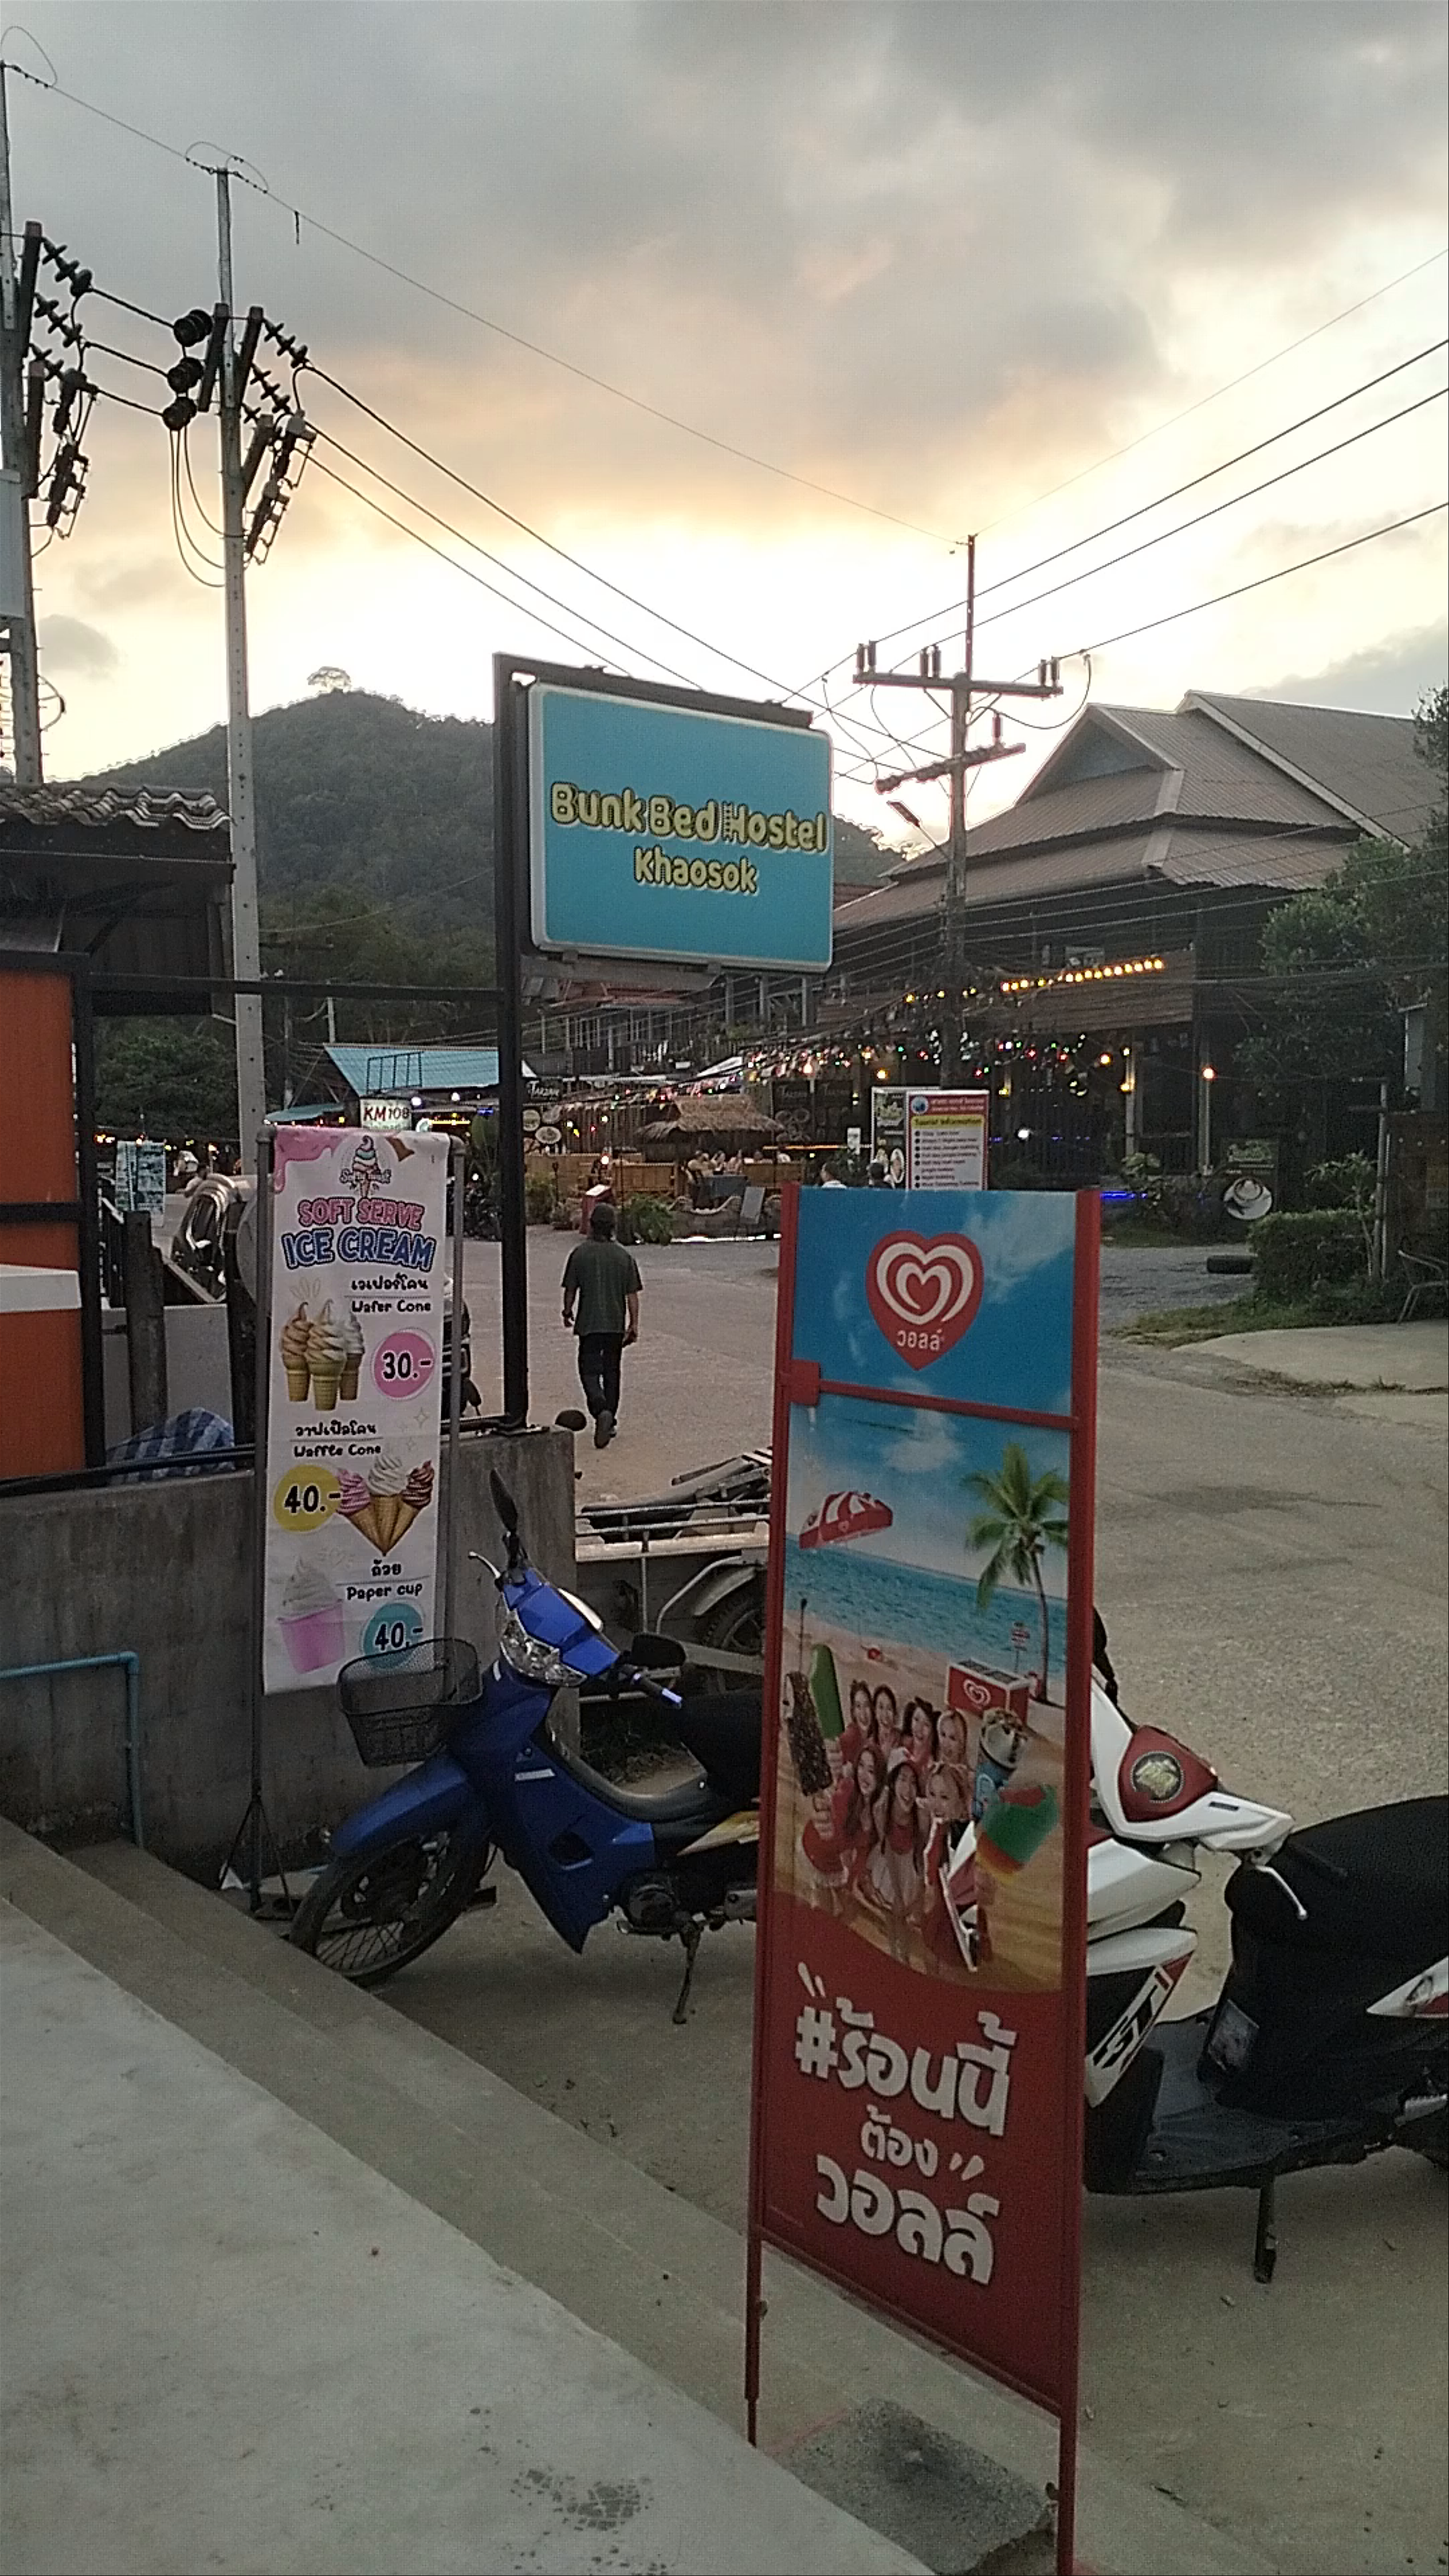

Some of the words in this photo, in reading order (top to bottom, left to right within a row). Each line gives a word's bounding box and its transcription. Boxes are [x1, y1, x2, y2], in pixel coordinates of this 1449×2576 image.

[552, 782, 646, 832] Bunk
[649, 795, 719, 842] Bed
[722, 801, 828, 854] Hostel
[634, 846, 758, 895] Khaosok
[298, 1197, 355, 1226] SOFT
[356, 1196, 425, 1231] SERVE
[281, 1228, 334, 1269] ICE
[337, 1228, 436, 1271] CREAM
[352, 1300, 392, 1313] Wafer
[397, 1299, 431, 1312] Cone
[897, 1329, 943, 1351] วอลล์
[381, 1352, 433, 1380] 30.-
[294, 1444, 344, 1457] Waffle
[348, 1444, 381, 1456] Cone
[284, 1485, 341, 1514] 40.-
[346, 1586, 392, 1601] Paper
[397, 1583, 423, 1596] cup
[794, 1996, 1018, 2136] #ร้อนนี้
[860, 2104, 939, 2177] ต้อง
[815, 2153, 1000, 2286] วอลล์
